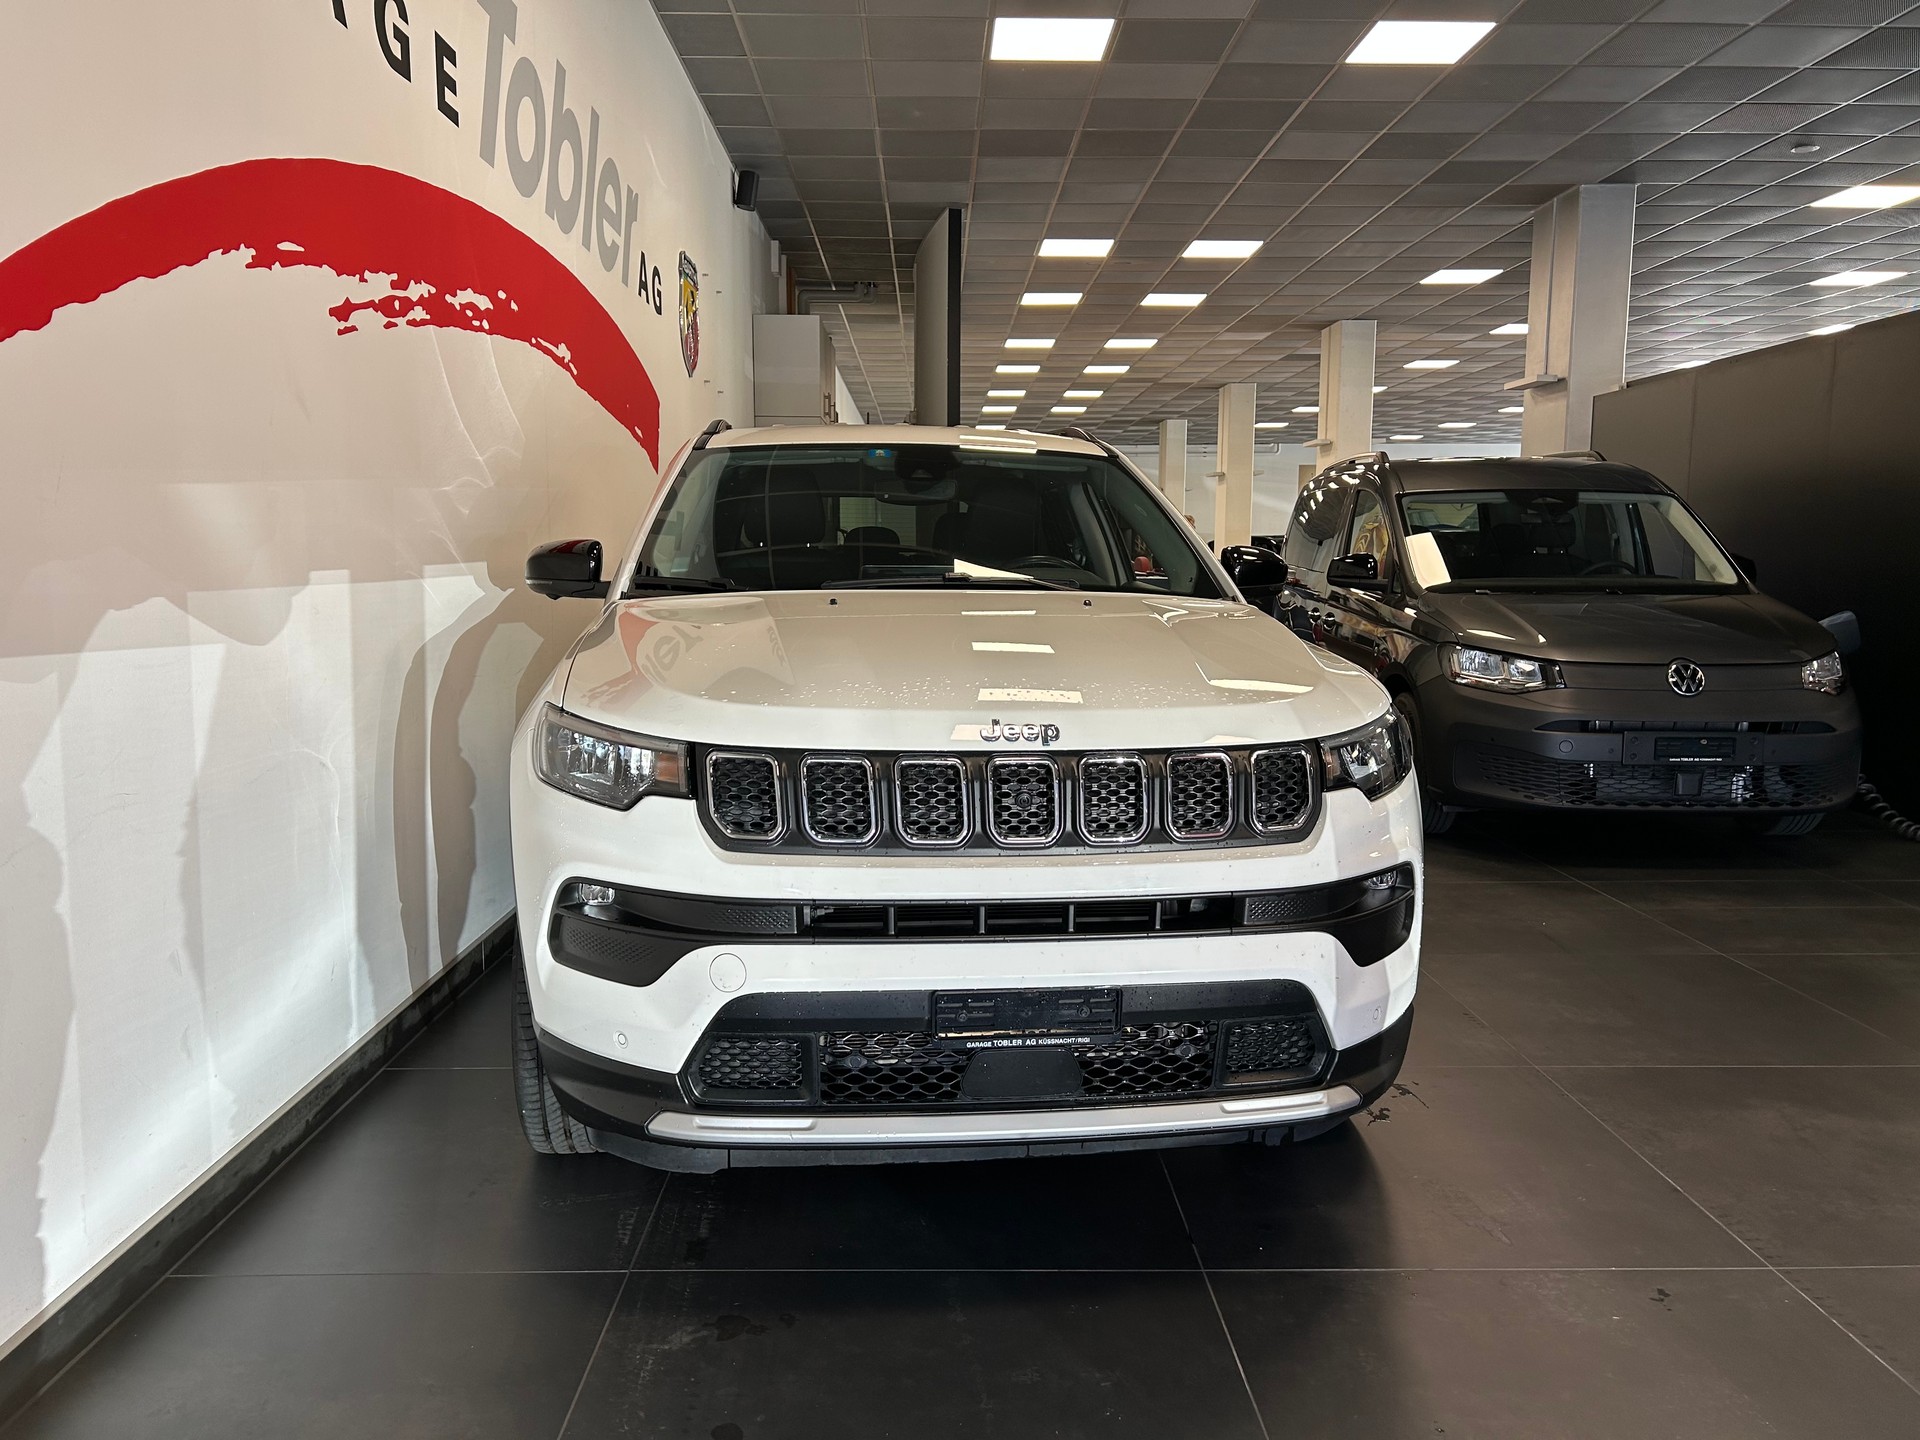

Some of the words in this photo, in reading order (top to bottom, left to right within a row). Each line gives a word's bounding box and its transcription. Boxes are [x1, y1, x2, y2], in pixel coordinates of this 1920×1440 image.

[476, 0, 639, 288] Tobler
[638, 250, 662, 316] AG
[980, 719, 1060, 746] Jeep
[993, 1039, 1023, 1047] TOBLER
[1025, 1038, 1037, 1046] AG
